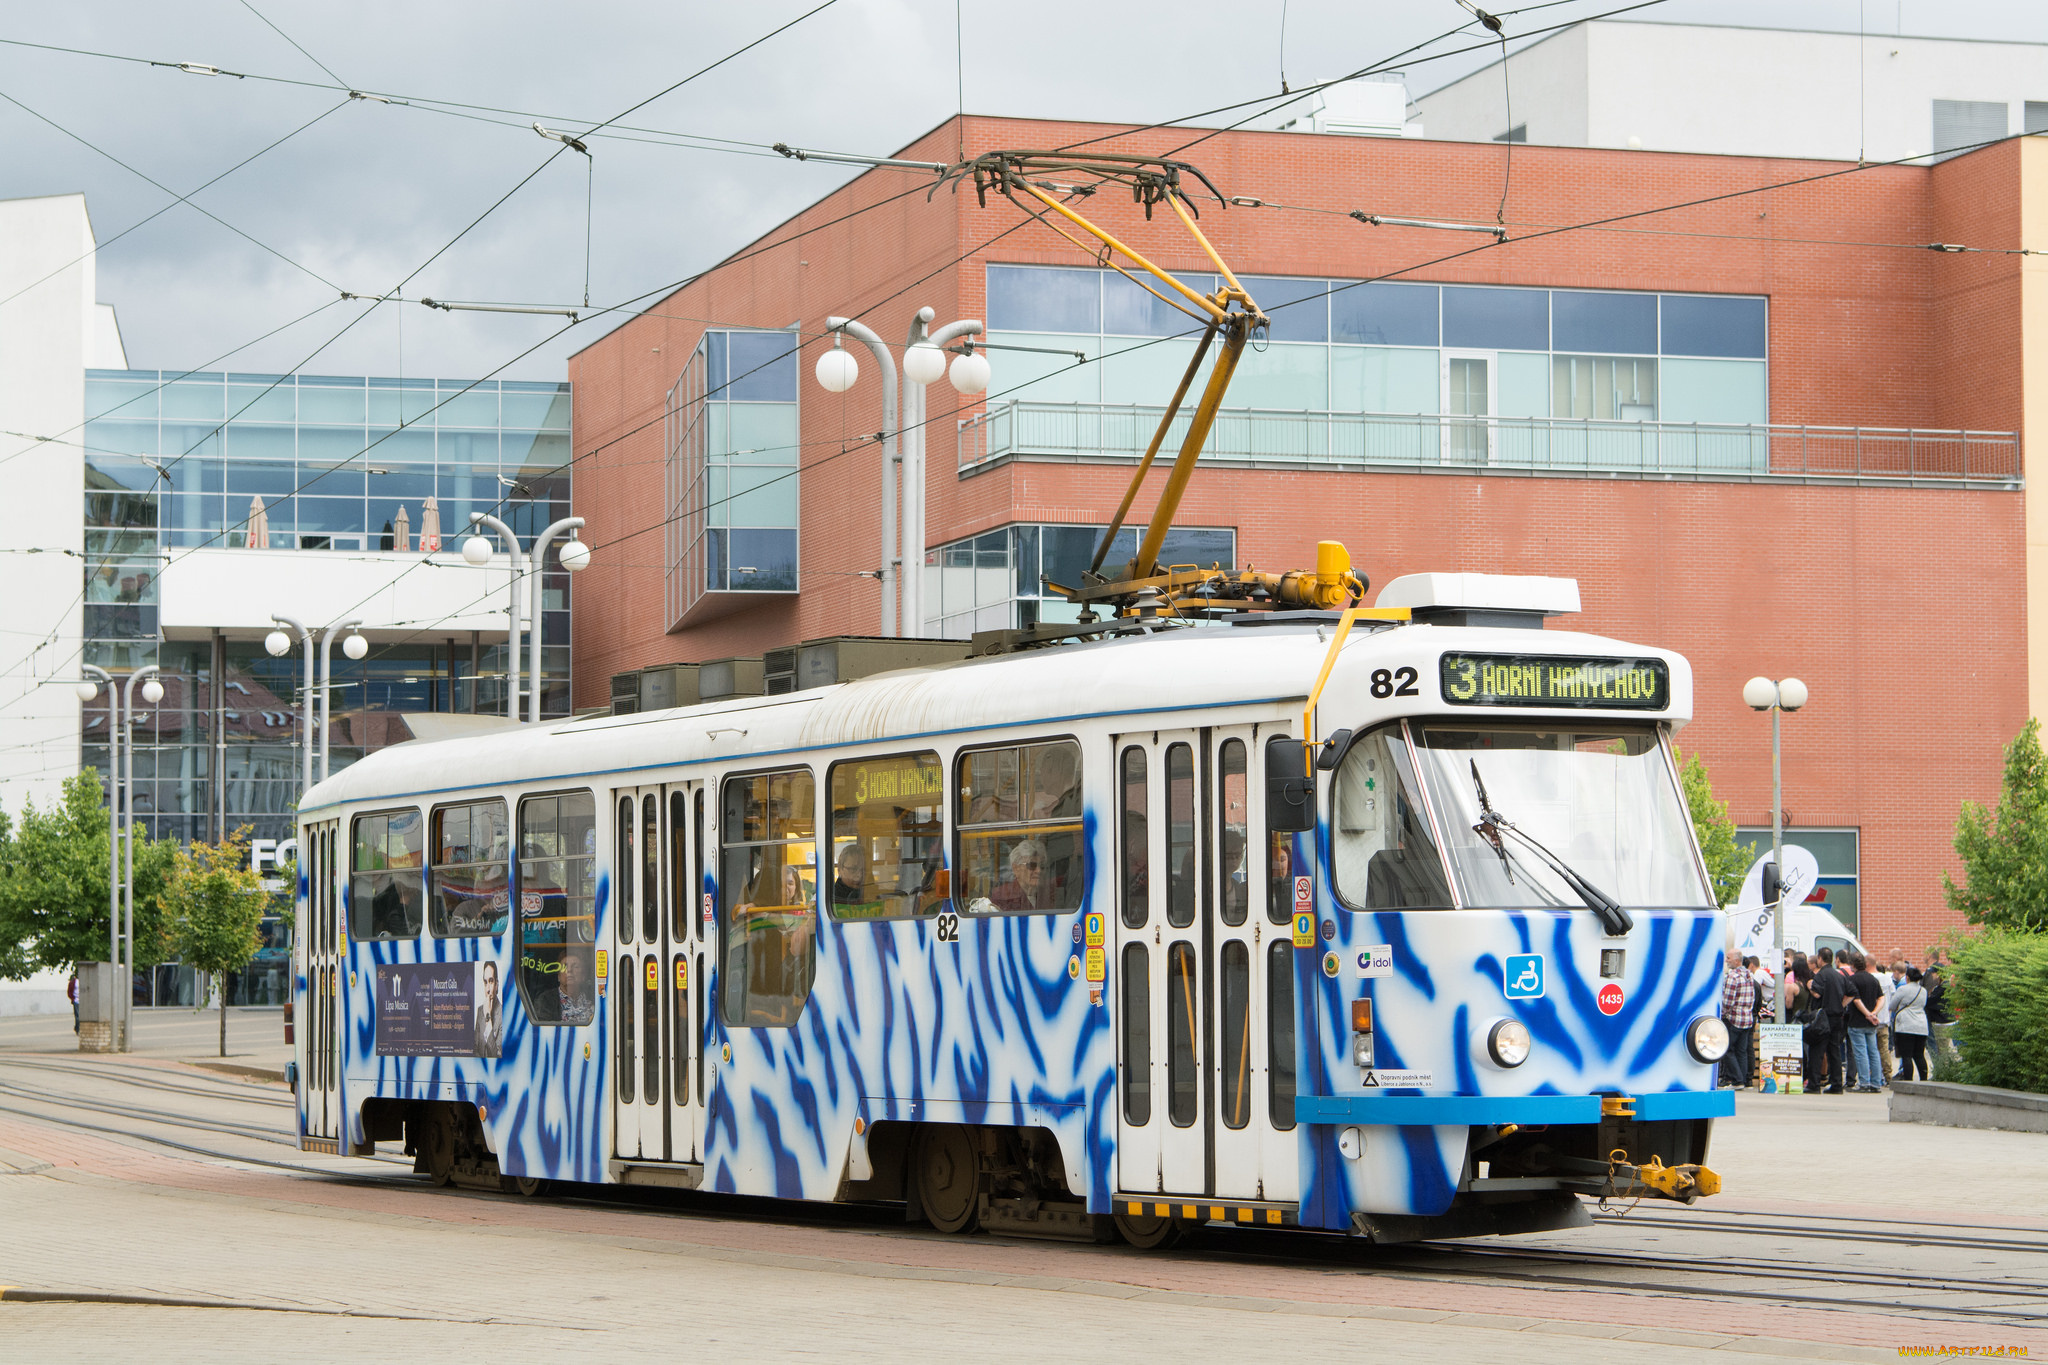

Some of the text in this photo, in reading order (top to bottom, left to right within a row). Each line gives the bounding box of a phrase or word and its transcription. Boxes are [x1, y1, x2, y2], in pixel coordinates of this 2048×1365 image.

[1370, 666, 1419, 699] 82
[1450, 658, 1655, 699] 3 HORNÍ HANYCHOV
[856, 766, 868, 804] 3
[870, 765, 898, 799] HORNÍ
[937, 914, 959, 942] 82
[1373, 957, 1391, 967] idol
[433, 980, 448, 989] Mozart
[1600, 994, 1623, 1005] 1435
[385, 1000, 409, 1013] Lipa Musica
[1419, 1073, 1432, 1081] měst
